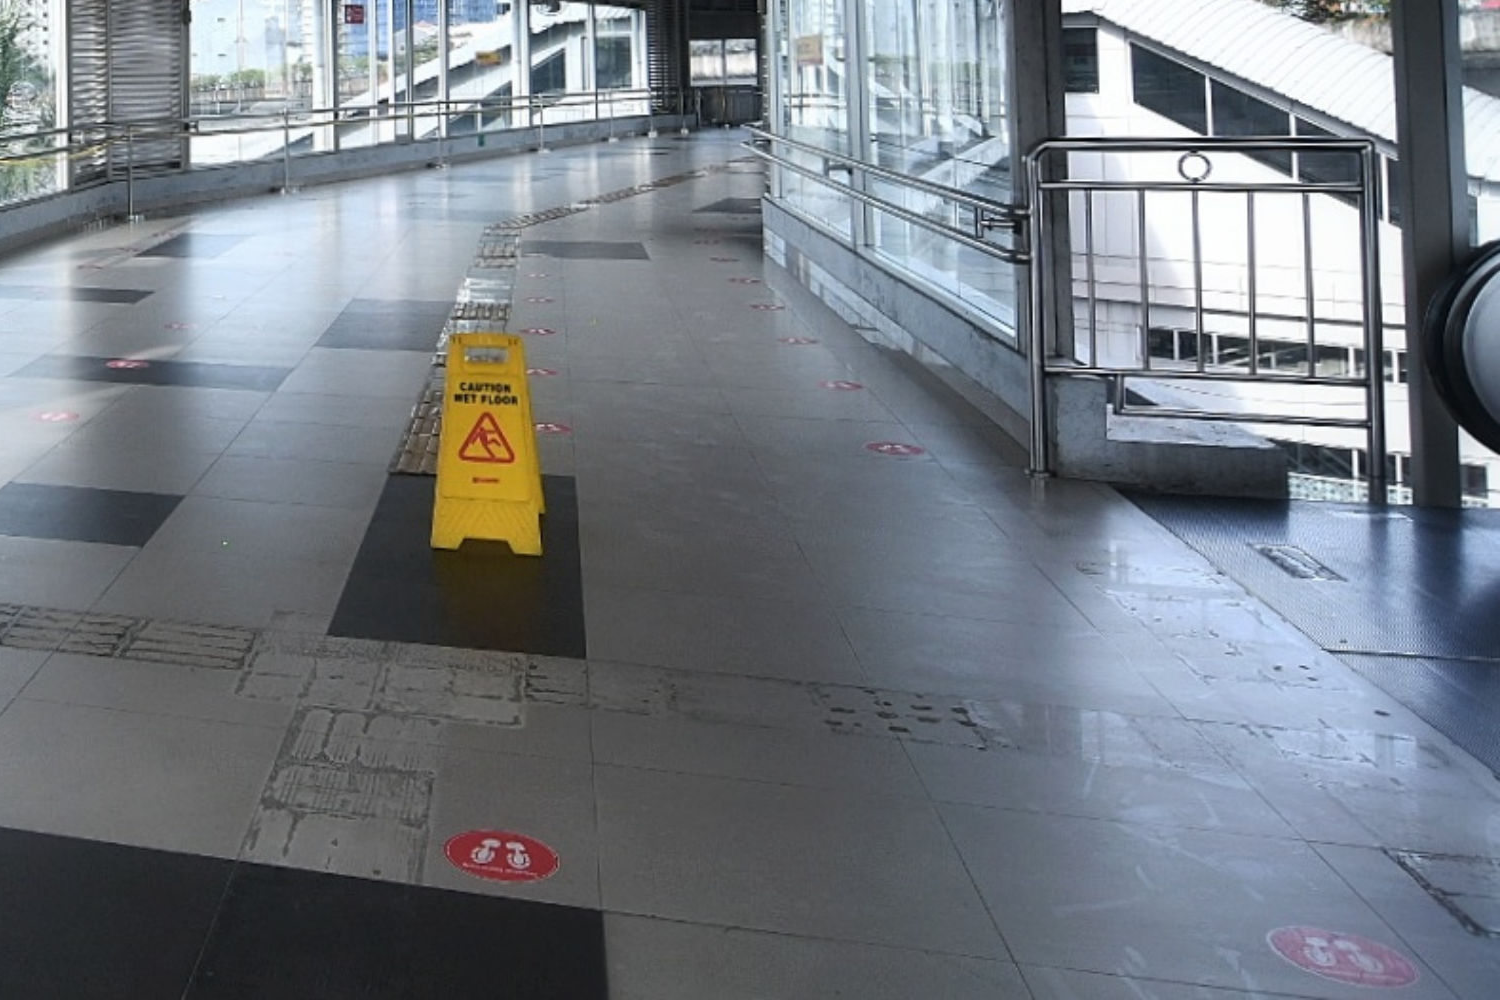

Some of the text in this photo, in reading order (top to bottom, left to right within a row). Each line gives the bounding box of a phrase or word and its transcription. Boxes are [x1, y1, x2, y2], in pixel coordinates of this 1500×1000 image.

[459, 382, 511, 393] CAUTION
[454, 394, 518, 405] WET FLOOR
